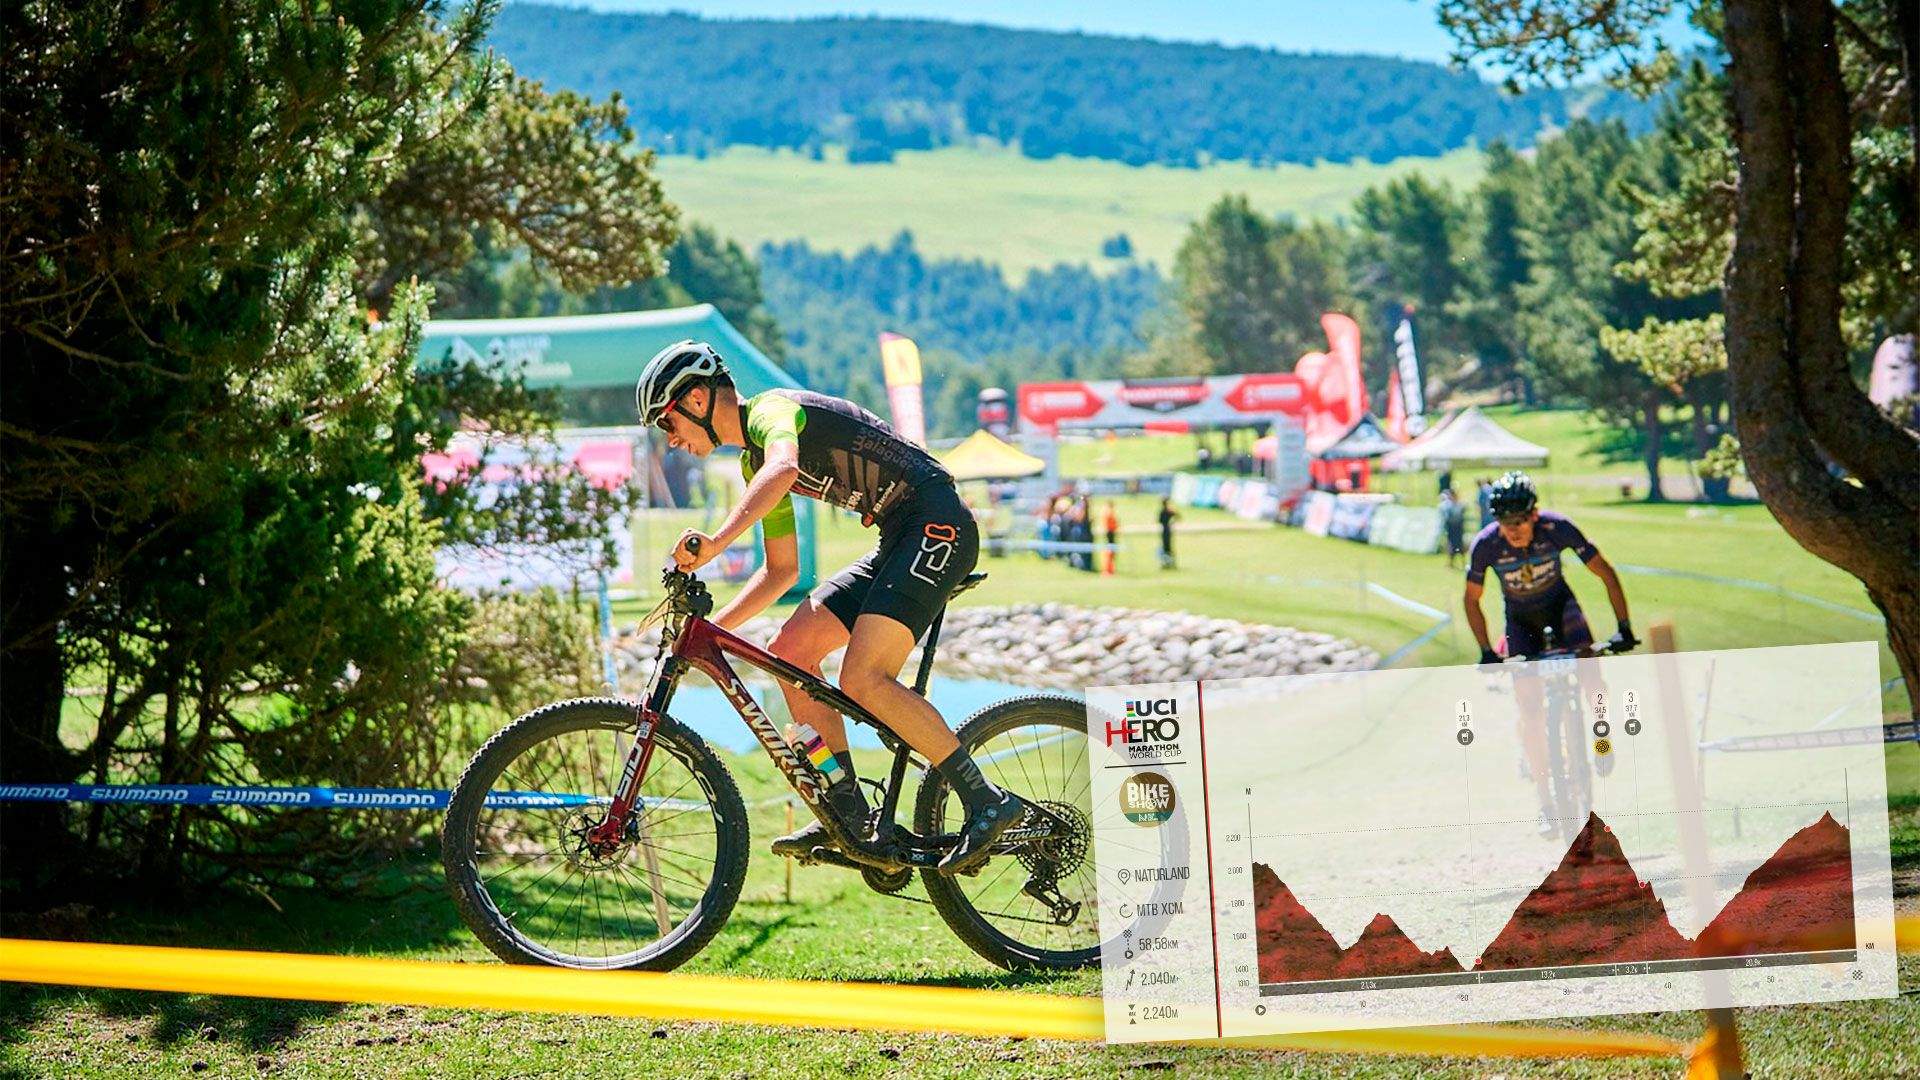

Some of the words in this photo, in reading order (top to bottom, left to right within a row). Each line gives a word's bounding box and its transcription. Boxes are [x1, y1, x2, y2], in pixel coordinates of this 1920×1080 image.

[719, 678, 829, 805] S-WORKS
[90, 788, 189, 801] SHIMANO
[210, 789, 311, 804] SHIMANO
[333, 791, 436, 806] SHIMANO
